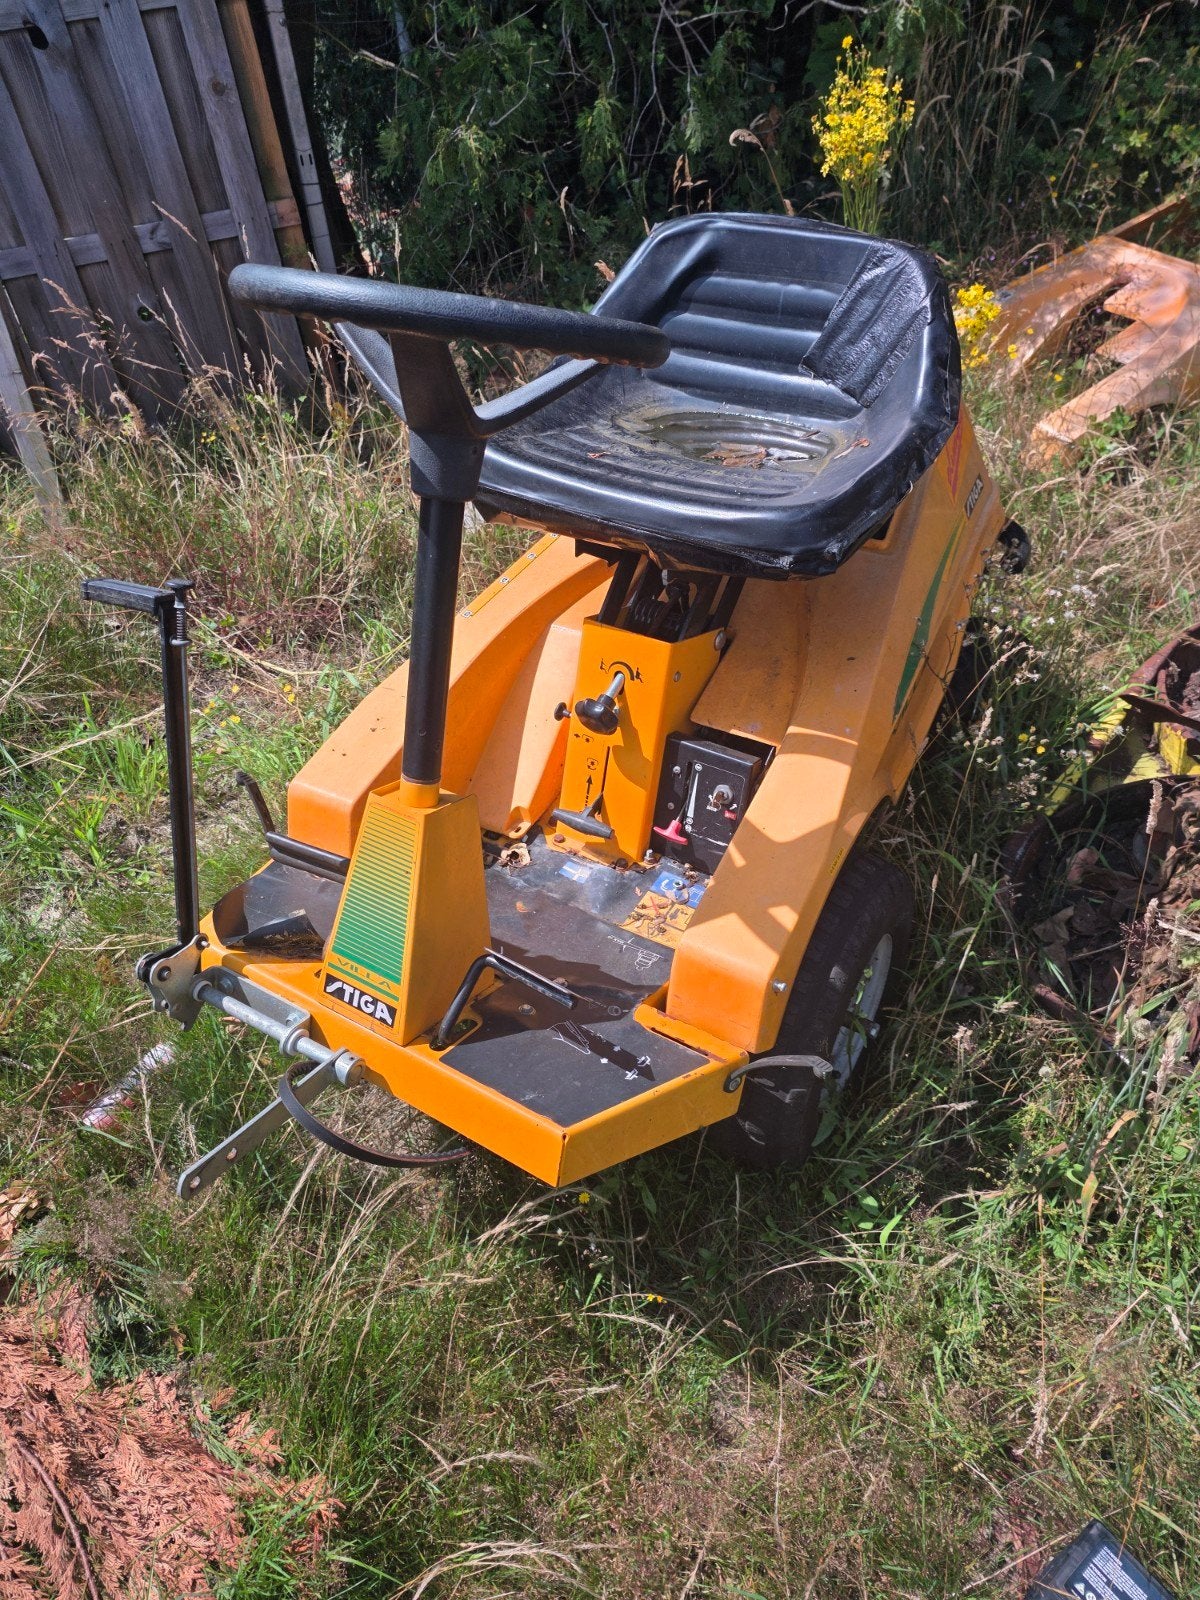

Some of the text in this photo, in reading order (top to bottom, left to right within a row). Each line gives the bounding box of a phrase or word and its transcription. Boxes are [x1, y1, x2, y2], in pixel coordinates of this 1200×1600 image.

[966, 478, 984, 518] STIGA
[337, 957, 391, 990] VILLA
[325, 981, 393, 1026] STIGA
